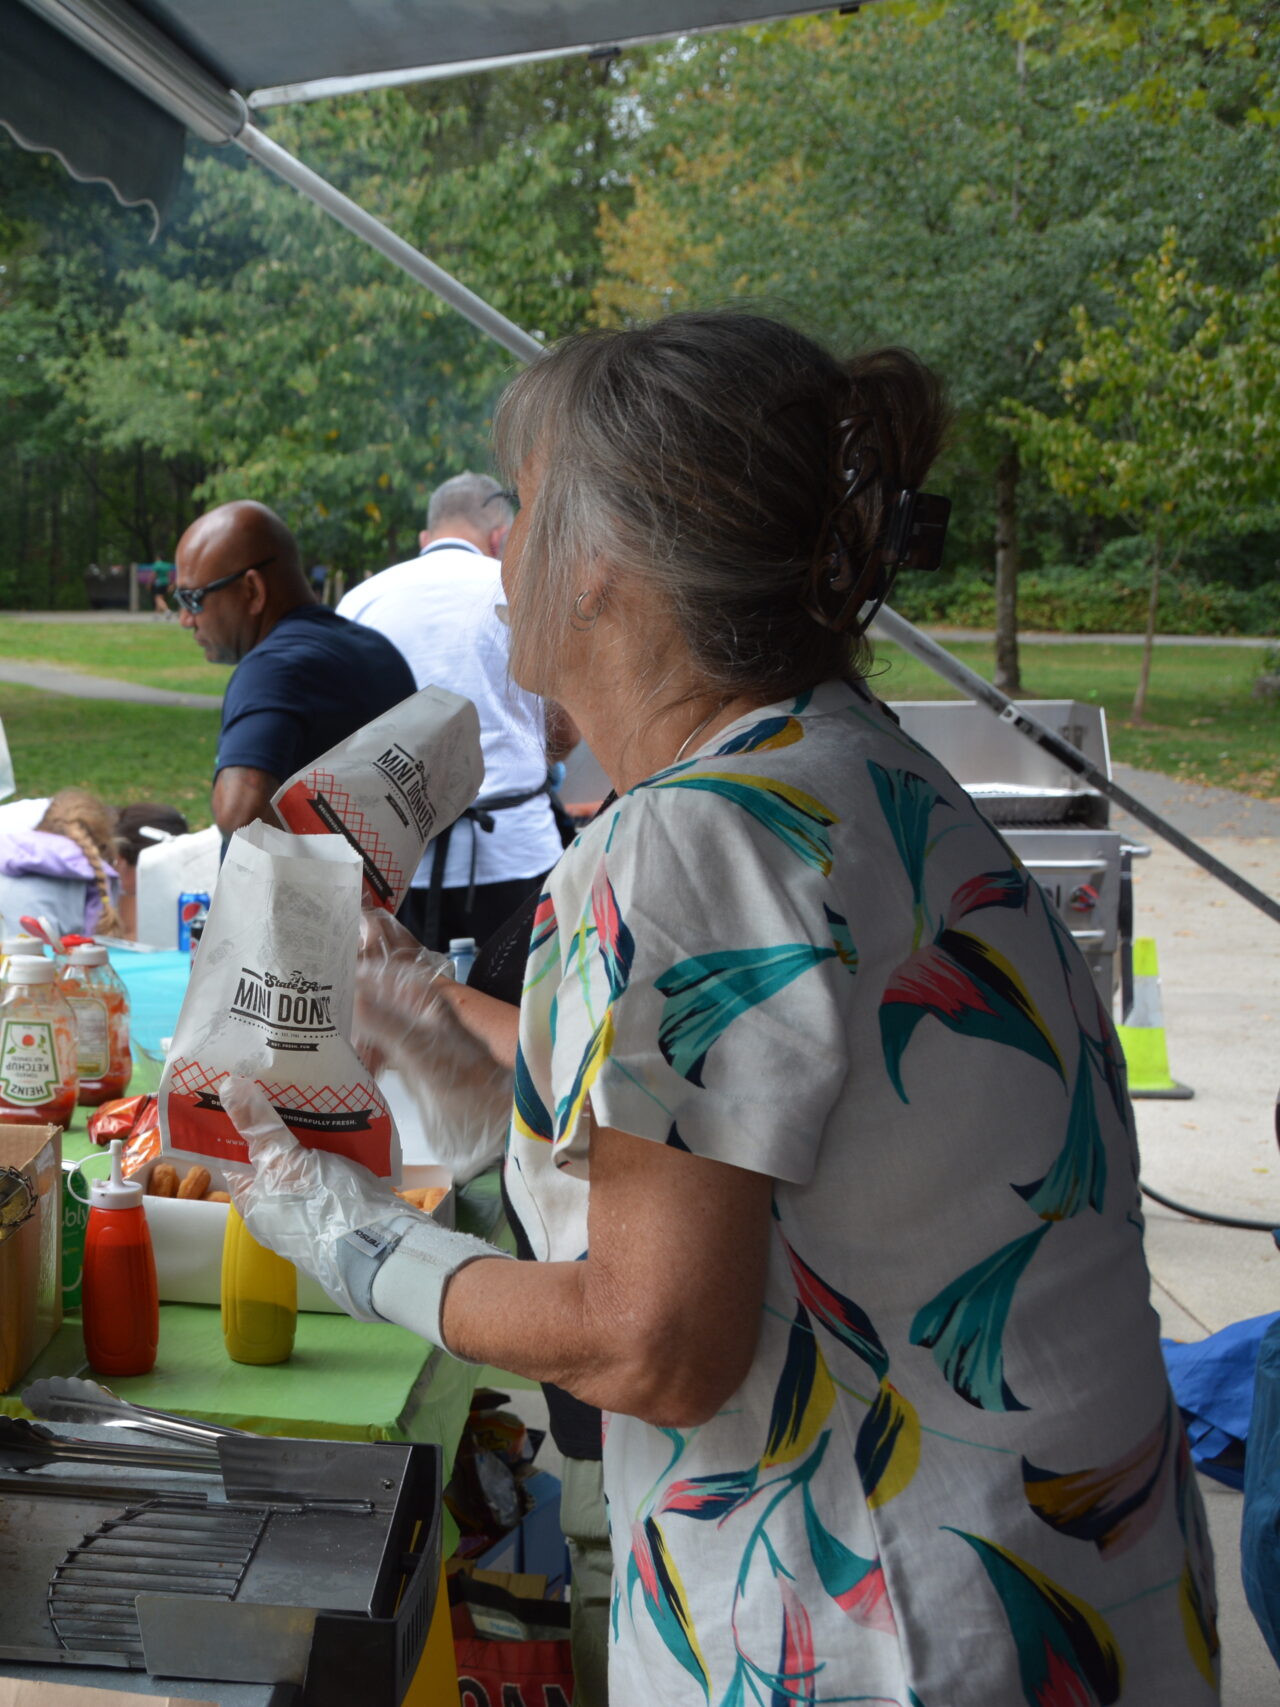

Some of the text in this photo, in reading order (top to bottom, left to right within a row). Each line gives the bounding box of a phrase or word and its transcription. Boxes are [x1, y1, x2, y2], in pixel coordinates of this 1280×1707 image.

[377, 748, 416, 786] MINI
[406, 780, 434, 838] DONUTS
[265, 971, 299, 990] State
[233, 977, 271, 1019] MINI
[5, 1062, 50, 1073] KETCHUP
[10, 1084, 45, 1097] HEINZ
